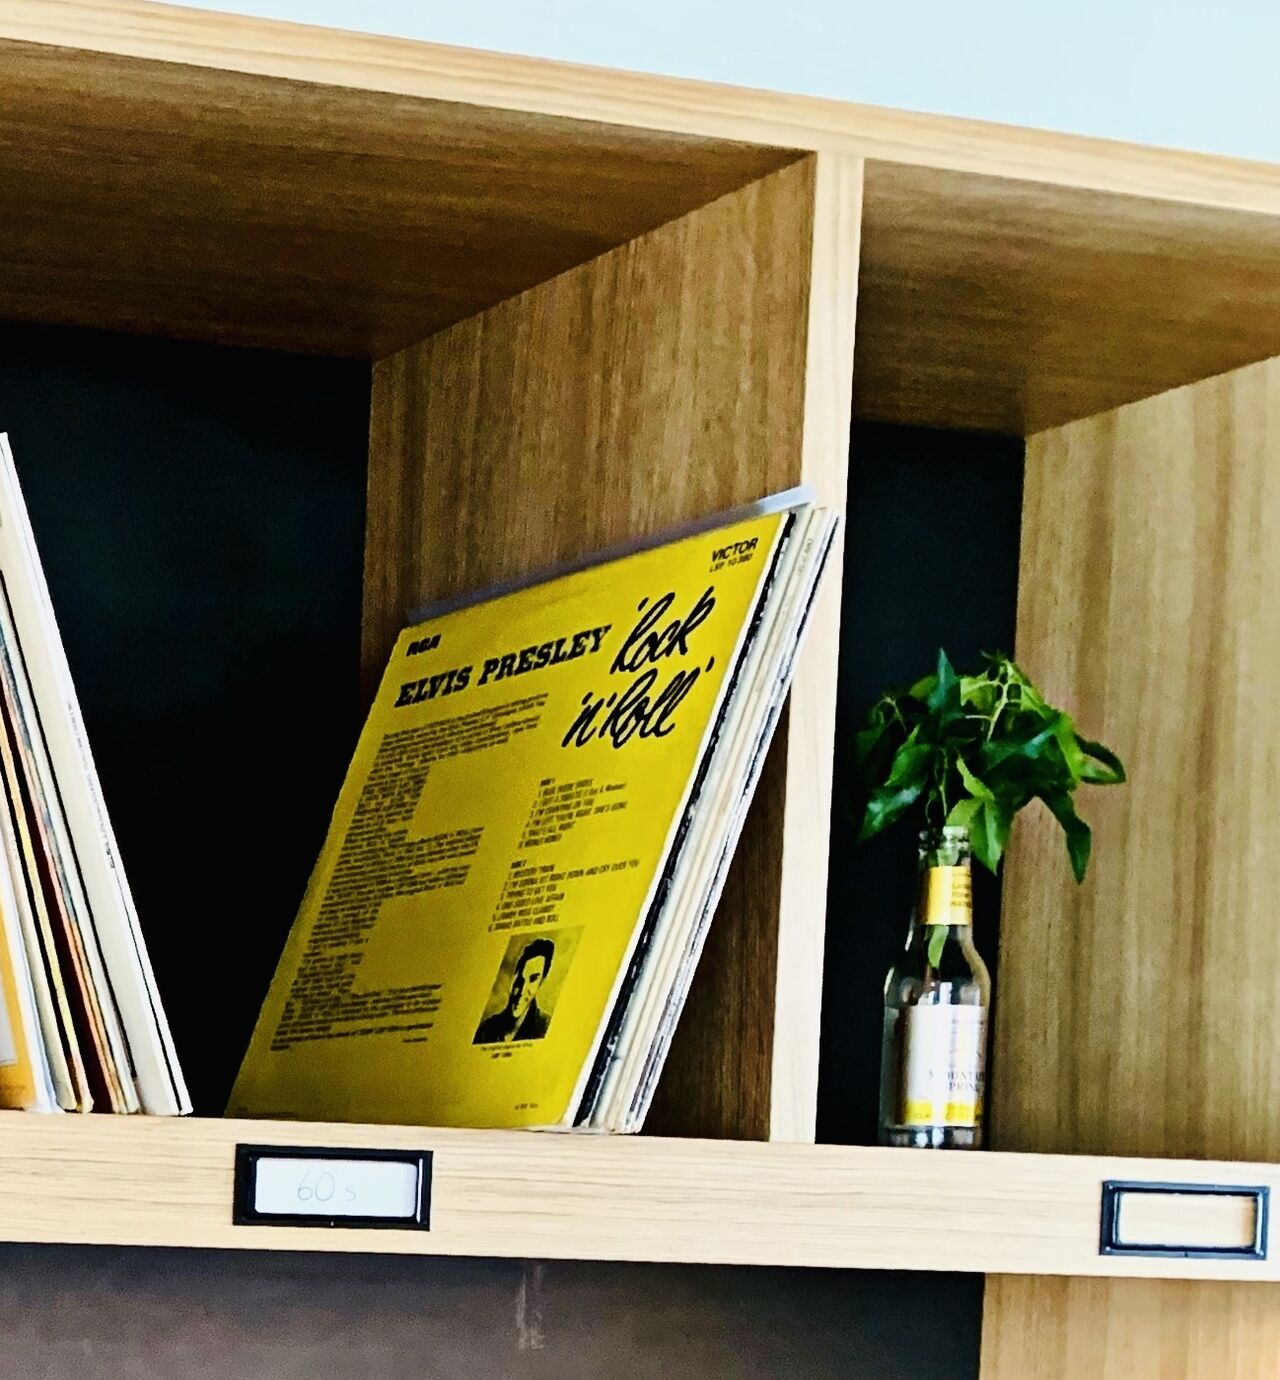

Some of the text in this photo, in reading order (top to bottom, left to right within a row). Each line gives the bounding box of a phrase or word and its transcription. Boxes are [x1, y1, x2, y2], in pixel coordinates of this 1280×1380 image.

[712, 537, 759, 562] VICTOR
[406, 634, 441, 656] RCA
[394, 624, 612, 708] ELVIS PRESLEY
